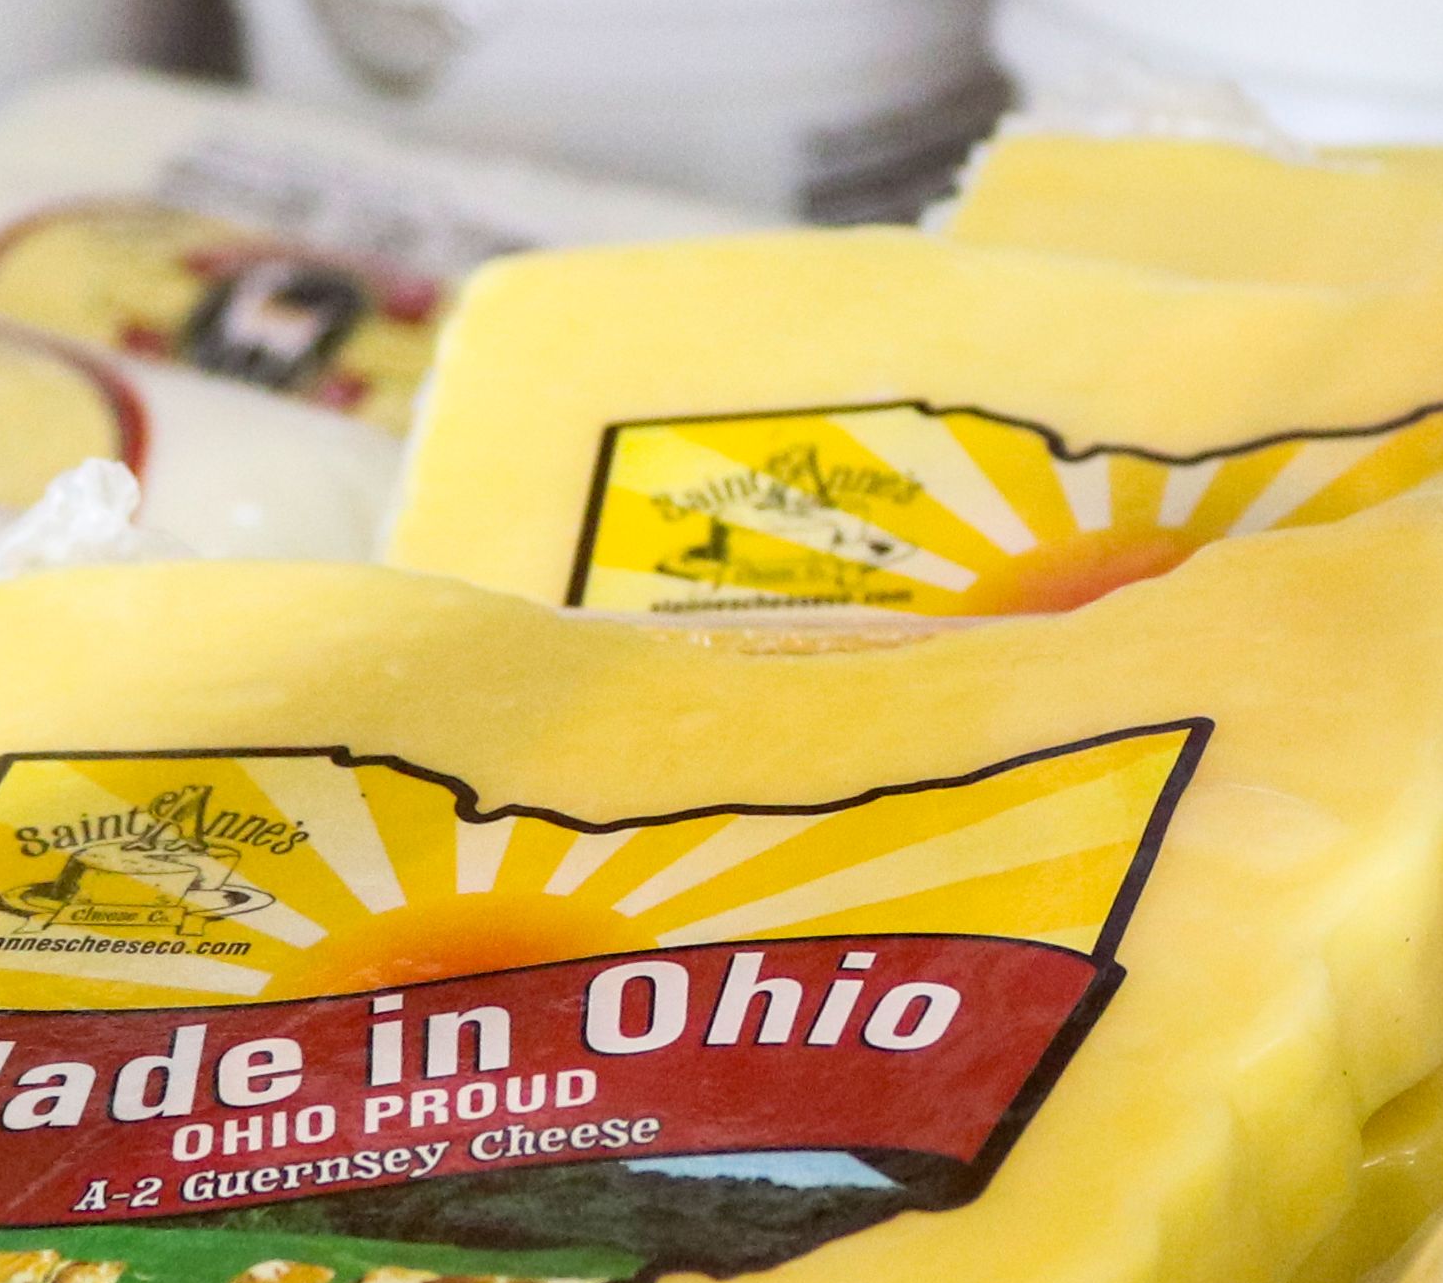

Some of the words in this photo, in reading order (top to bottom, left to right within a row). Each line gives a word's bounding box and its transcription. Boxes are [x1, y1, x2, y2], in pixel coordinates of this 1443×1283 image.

[14, 804, 149, 859] Saint
[147, 785, 311, 856] Anne's
[368, 993, 513, 1088] in
[583, 951, 964, 1056] Ohio
[72, 1176, 164, 1212] A-2
[181, 1140, 452, 1203] Guernsey
[470, 1115, 661, 1162] Cheese
[171, 1104, 337, 1163] OHIO
[363, 1068, 598, 1136] PROUD
